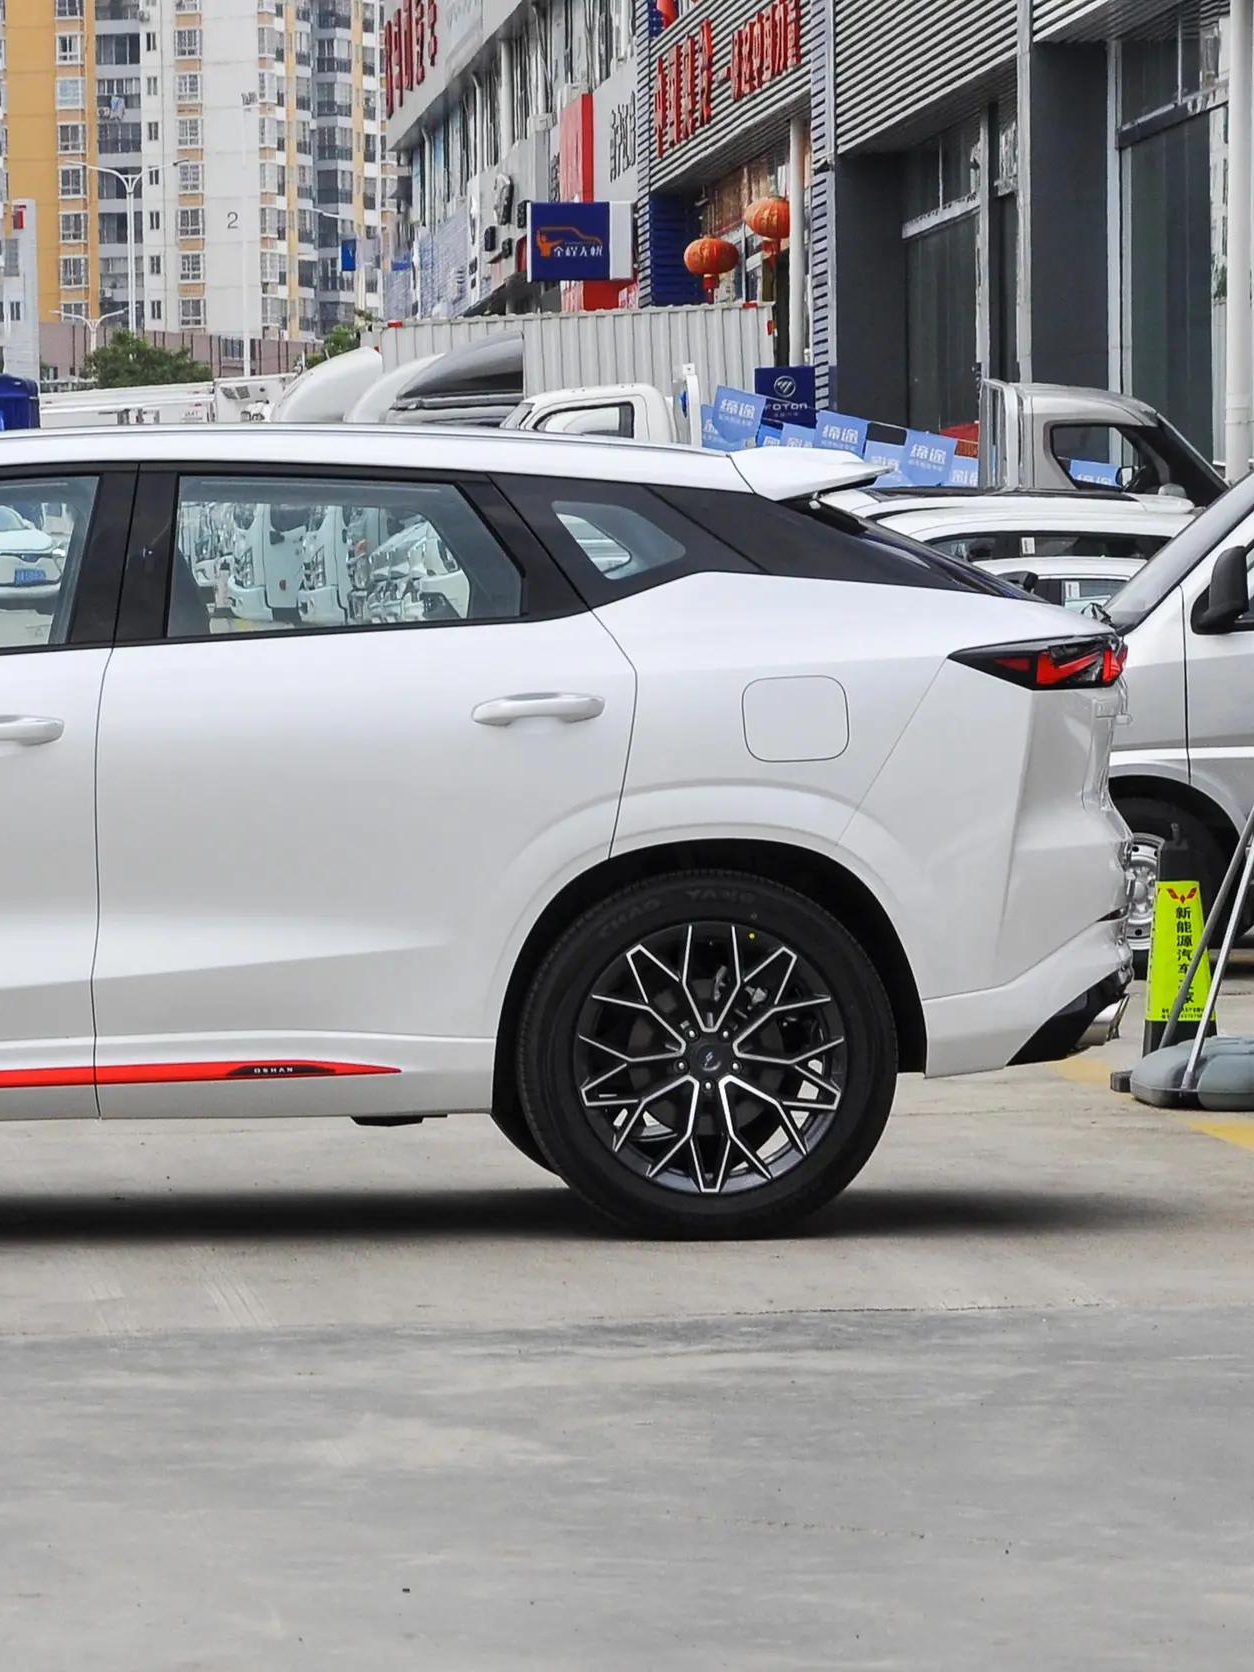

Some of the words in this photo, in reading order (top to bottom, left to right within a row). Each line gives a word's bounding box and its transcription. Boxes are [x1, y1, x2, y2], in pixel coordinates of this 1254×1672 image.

[226, 211, 239, 229] 2
[1176, 906, 1194, 1003] 新能源汽车
[253, 1066, 294, 1074] OSHAN
